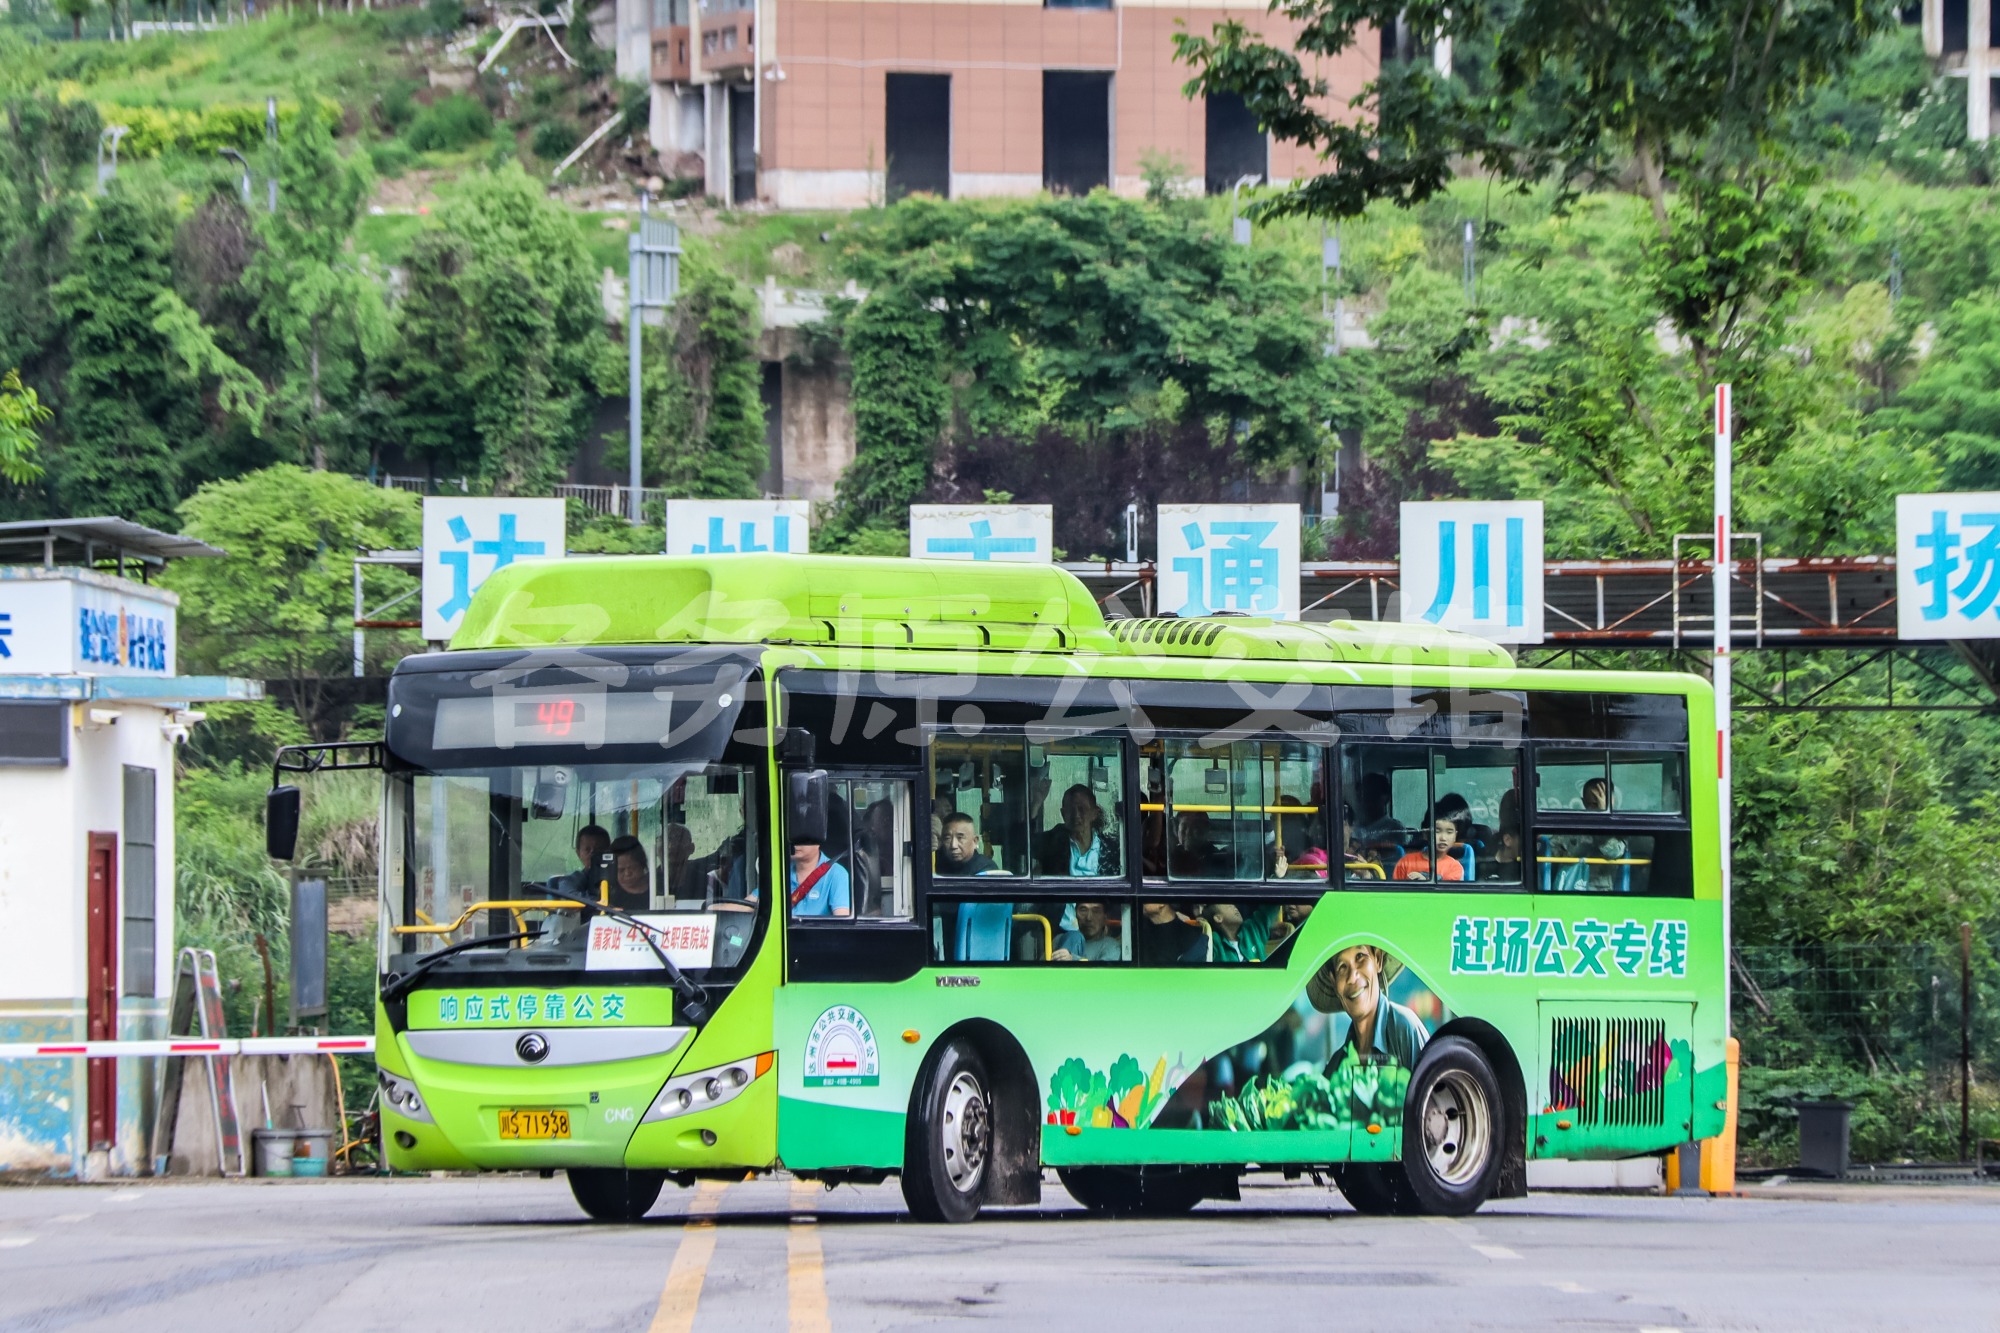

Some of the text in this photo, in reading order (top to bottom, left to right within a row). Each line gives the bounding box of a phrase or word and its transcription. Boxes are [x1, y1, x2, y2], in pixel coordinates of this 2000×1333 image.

[537, 699, 574, 736] 49
[660, 926, 710, 951] 达职医院站
[1451, 917, 1687, 976] 赶场公交专线
[935, 975, 981, 987] YUTONG
[440, 994, 625, 1021] 响应式停靠公交
[807, 1007, 876, 1075] 达州市公共交通有限公司
[604, 1108, 634, 1123] CNG
